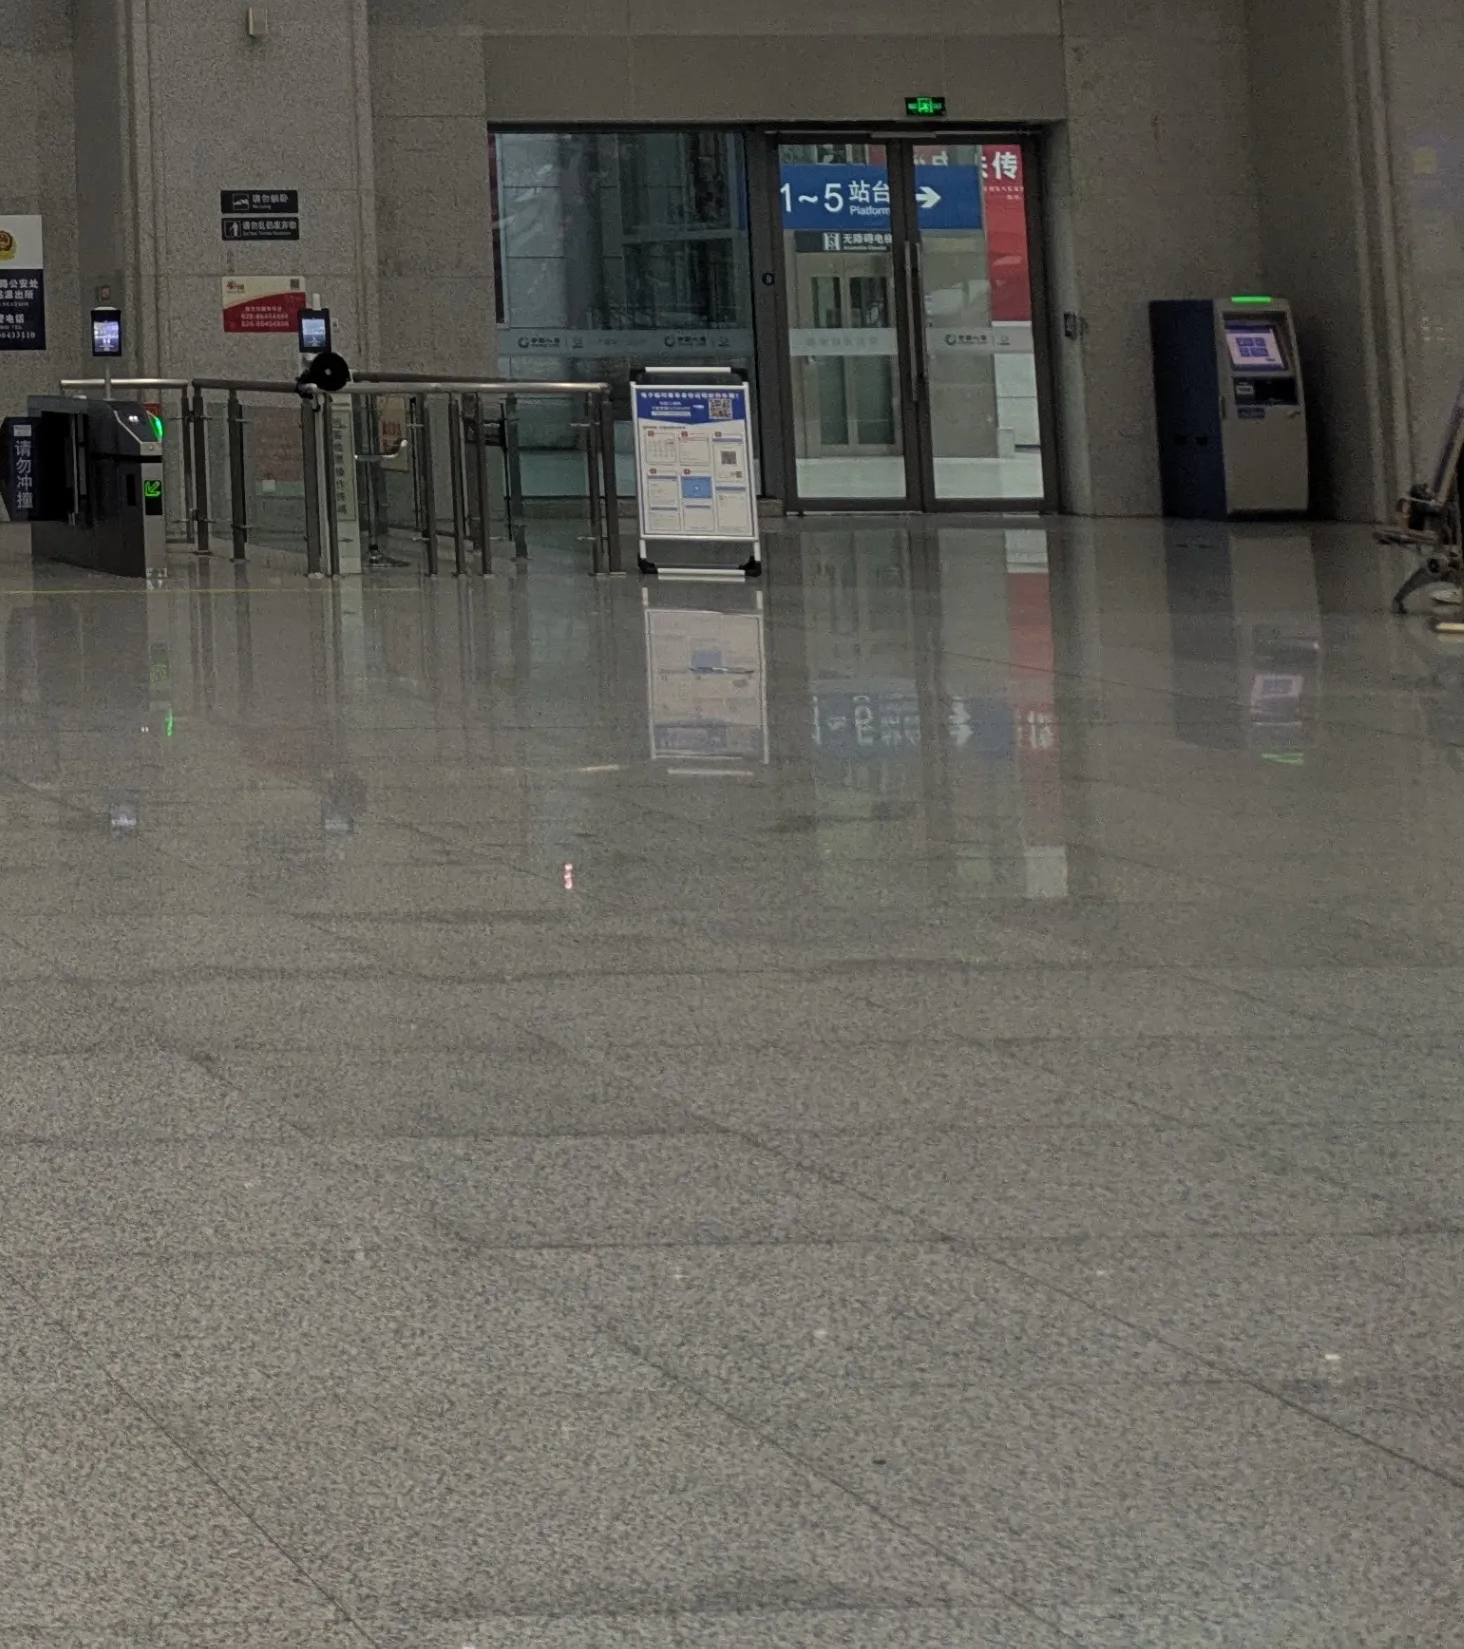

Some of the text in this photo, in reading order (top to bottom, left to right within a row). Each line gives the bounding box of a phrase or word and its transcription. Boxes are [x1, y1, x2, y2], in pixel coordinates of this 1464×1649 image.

[848, 180, 890, 204] 站台
[16, 440, 34, 510] 请勿冲撞
